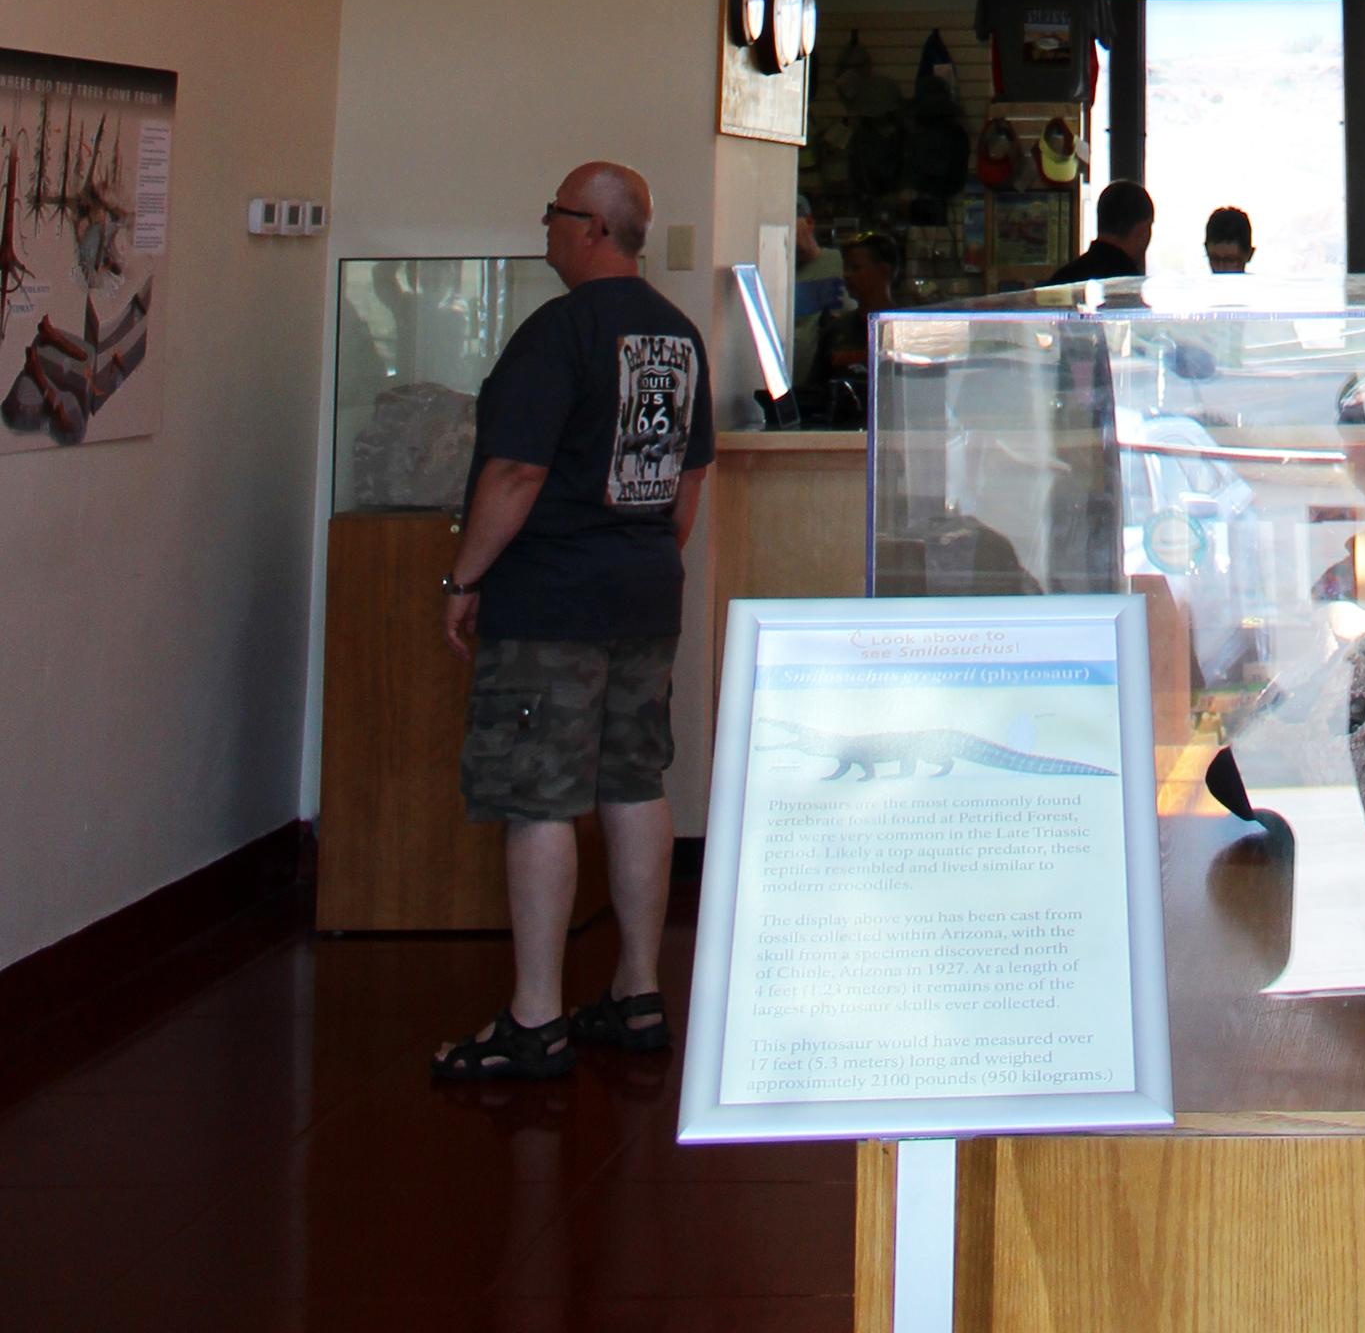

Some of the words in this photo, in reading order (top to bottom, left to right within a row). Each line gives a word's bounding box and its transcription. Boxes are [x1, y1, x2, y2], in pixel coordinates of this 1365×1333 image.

[637, 407, 669, 434] 66
[616, 478, 675, 502] ARIZON
[872, 633, 915, 645] Look
[923, 632, 979, 643] above
[984, 631, 1006, 641] to
[861, 649, 891, 658] see
[980, 666, 1090, 683] (phytosaur)
[884, 797, 909, 808] the
[911, 797, 950, 808] most
[952, 795, 1034, 809] commonly
[1036, 794, 1082, 806] found
[892, 812, 937, 824] found
[940, 813, 955, 823] at
[959, 811, 1023, 823] Petrified
[1028, 810, 1078, 822] Forest,
[765, 831, 794, 842] and
[839, 832, 874, 843] very
[877, 831, 944, 840] common
[948, 828, 963, 839] in
[967, 827, 991, 838] the
[996, 827, 1029, 838] Late
[1032, 825, 1090, 837] Triassic
[822, 845, 871, 859] Likely
[874, 848, 884, 856] a
[886, 846, 913, 859] top
[916, 843, 973, 858] aquatic
[977, 842, 1047, 857] predator,
[1050, 841, 1091, 853] these
[906, 860, 936, 872] and
[941, 859, 978, 871] lived
[980, 858, 1035, 870] similar
[1037, 859, 1054, 869] to
[762, 880, 824, 891] modern
[827, 878, 913, 890] crocodiles.
[761, 914, 791, 925] The
[794, 912, 851, 927] display
[854, 911, 901, 923] above
[904, 913, 935, 925] you
[937, 910, 965, 921] has
[968, 909, 1006, 921] been
[1009, 909, 1041, 920] cast
[1044, 907, 1083, 919] from
[758, 930, 807, 942] fossils
[810, 928, 880, 941] collected
[885, 927, 936, 939] within
[940, 926, 1007, 939] Arizona,
[1011, 925, 1046, 937] with
[1050, 924, 1075, 936] the
[756, 949, 796, 961] skull
[799, 949, 838, 960] from
[841, 951, 851, 959] a
[933, 943, 1020, 957] discovered
[1023, 942, 1068, 955] north
[755, 967, 775, 978] of
[839, 964, 903, 976] Arizona
[907, 963, 923, 975] in
[927, 962, 969, 974] 1927.
[973, 961, 992, 973] At
[994, 964, 1005, 972] a
[1007, 959, 1060, 975] length
[1063, 959, 1080, 971] of
[754, 985, 764, 996] 4
[768, 984, 798, 996] feet
[912, 981, 922, 993] it
[926, 979, 991, 992] remains
[994, 981, 1025, 990] one
[1028, 978, 1045, 990] of
[1048, 977, 1075, 989] the
[752, 1003, 807, 1018] largest
[810, 1002, 893, 1017] phytosaur
[895, 999, 943, 1012] skulls
[945, 1001, 981, 1010] ever
[984, 996, 1060, 1010] collected.
[751, 1039, 788, 1052] This
[791, 1039, 874, 1054] phytosaur
[877, 1036, 929, 1049] would
[932, 1035, 971, 1047] have
[974, 1032, 1054, 1046] measured
[1057, 1034, 1094, 1044] over
[773, 1058, 805, 1070] feet
[808, 1056, 838, 1073] (5.3
[909, 1054, 945, 1069] long
[949, 1052, 980, 1065] and
[984, 1050, 1052, 1067] weighed
[746, 1075, 869, 1093] approximately
[871, 1073, 911, 1086] 2100
[914, 1072, 976, 1089] pounds
[981, 1071, 1017, 1087] (950
